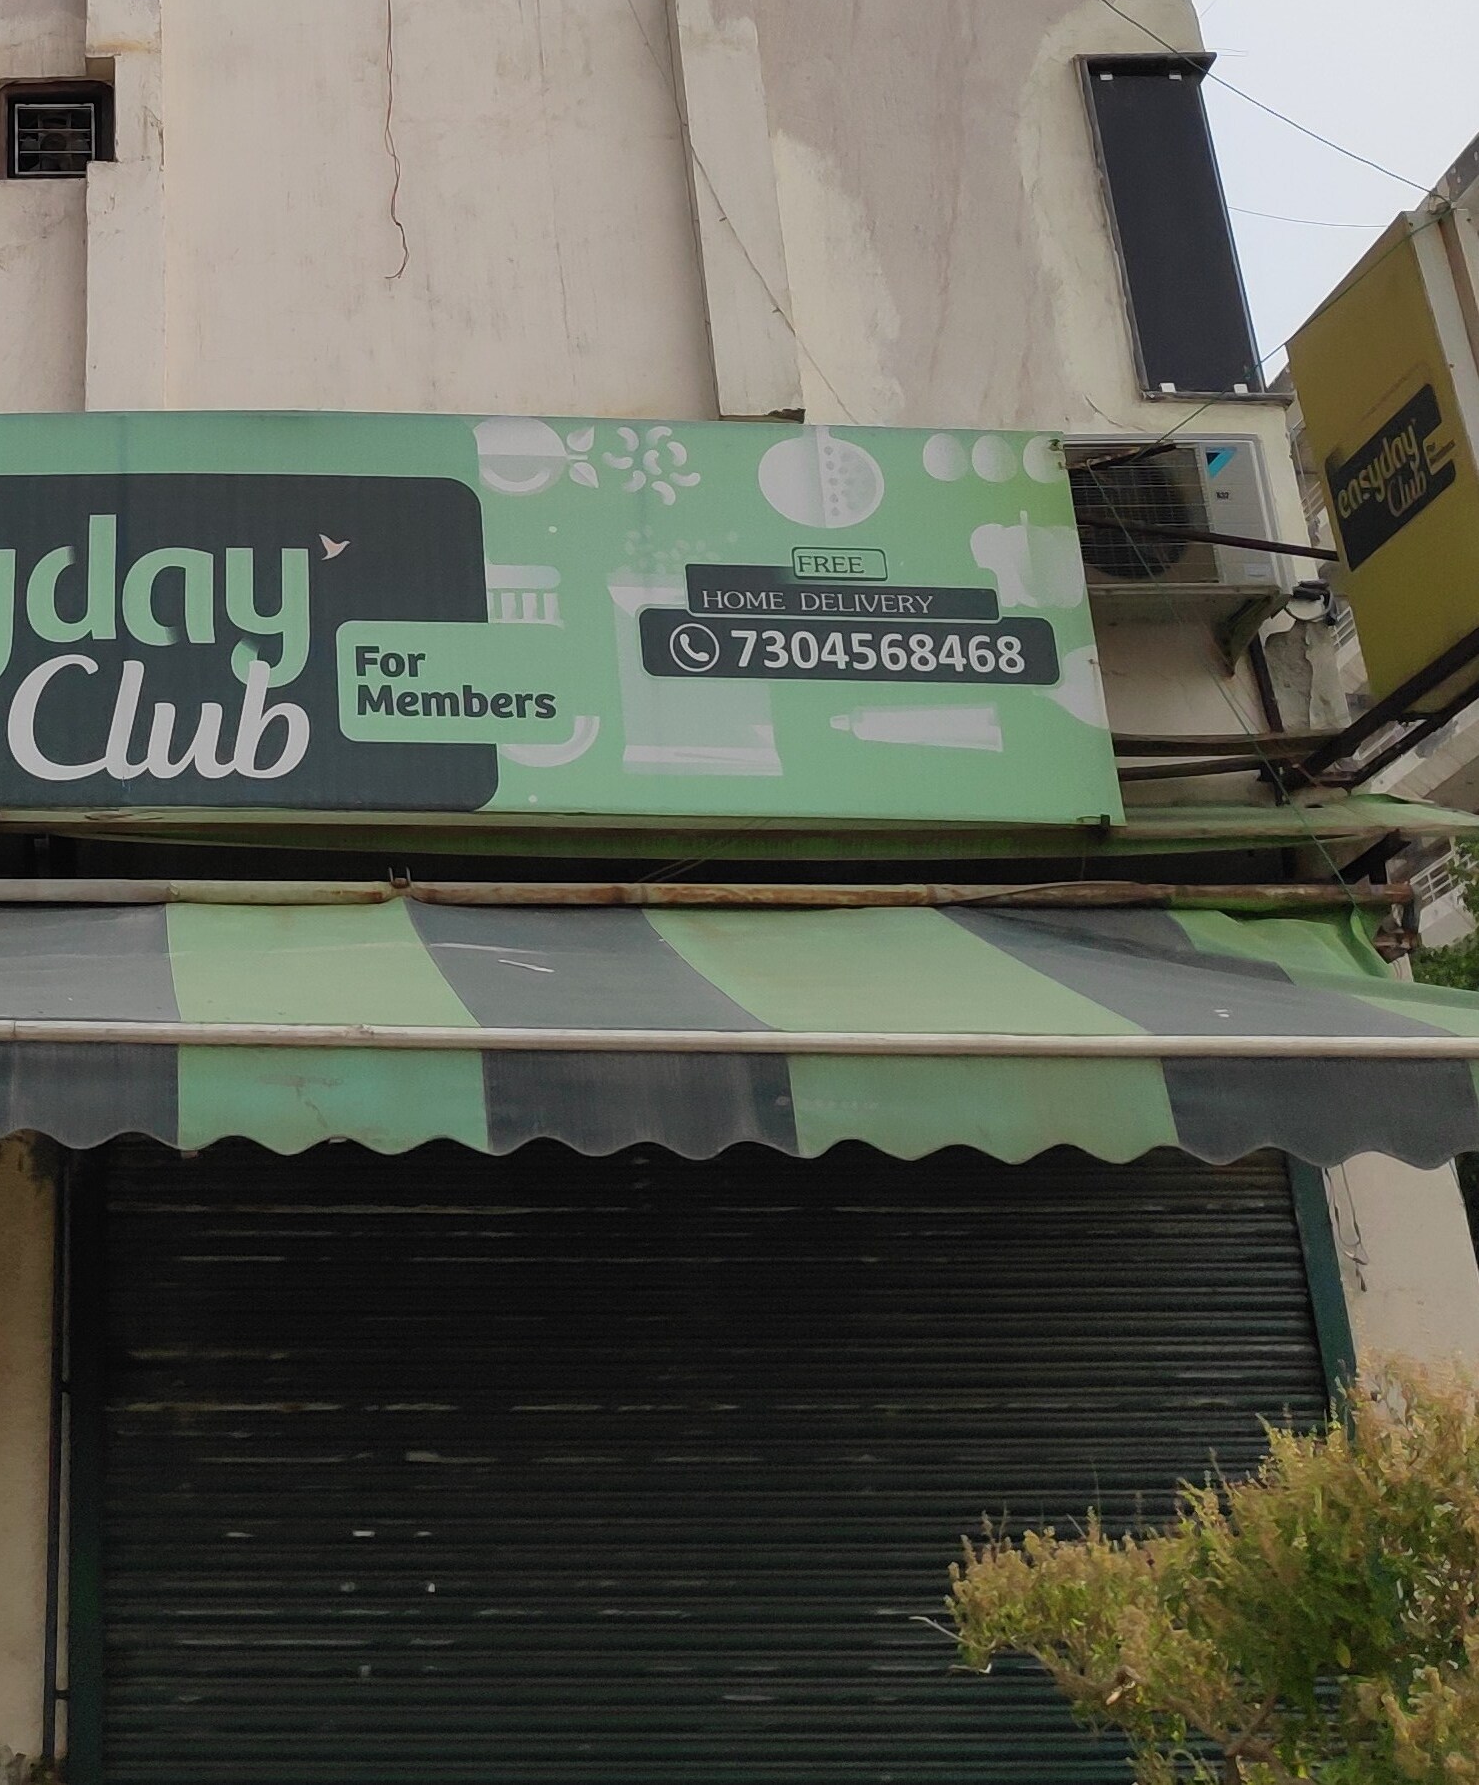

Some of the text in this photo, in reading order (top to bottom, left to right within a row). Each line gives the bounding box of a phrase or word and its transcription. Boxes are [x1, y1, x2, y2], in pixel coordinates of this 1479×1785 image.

[797, 554, 865, 574] FREE
[702, 589, 934, 614] HOME DELIVERY
[355, 645, 426, 678] For
[730, 629, 1026, 674] 7304568468
[7, 654, 310, 781] Club
[356, 684, 557, 719] Members
